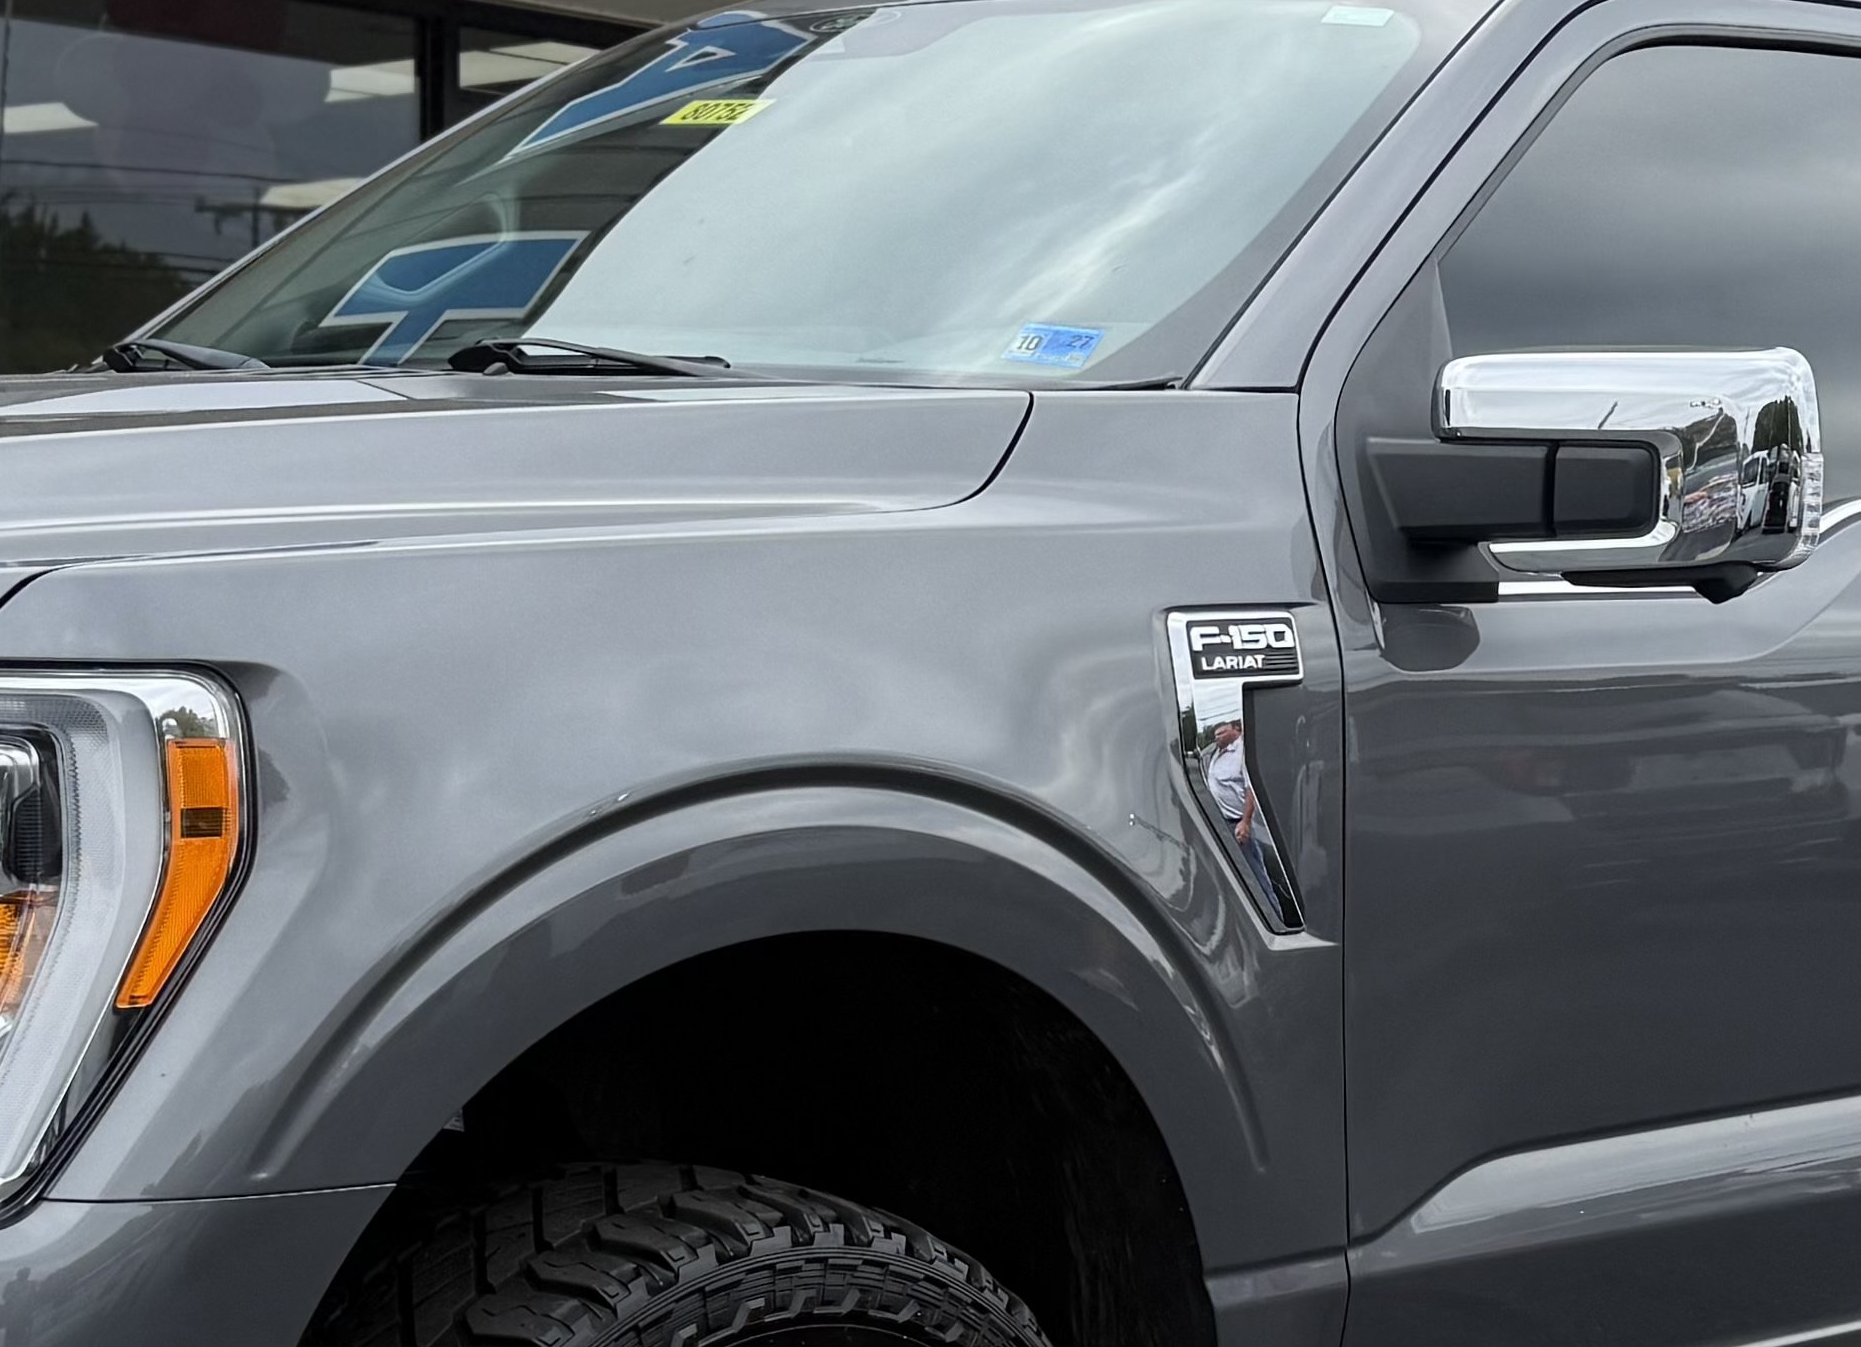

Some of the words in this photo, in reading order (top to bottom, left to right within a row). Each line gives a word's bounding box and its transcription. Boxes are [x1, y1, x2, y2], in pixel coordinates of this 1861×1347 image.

[1016, 335, 1043, 351] 10
[1190, 623, 1295, 652] F-150
[1201, 654, 1265, 671] LARIAT
